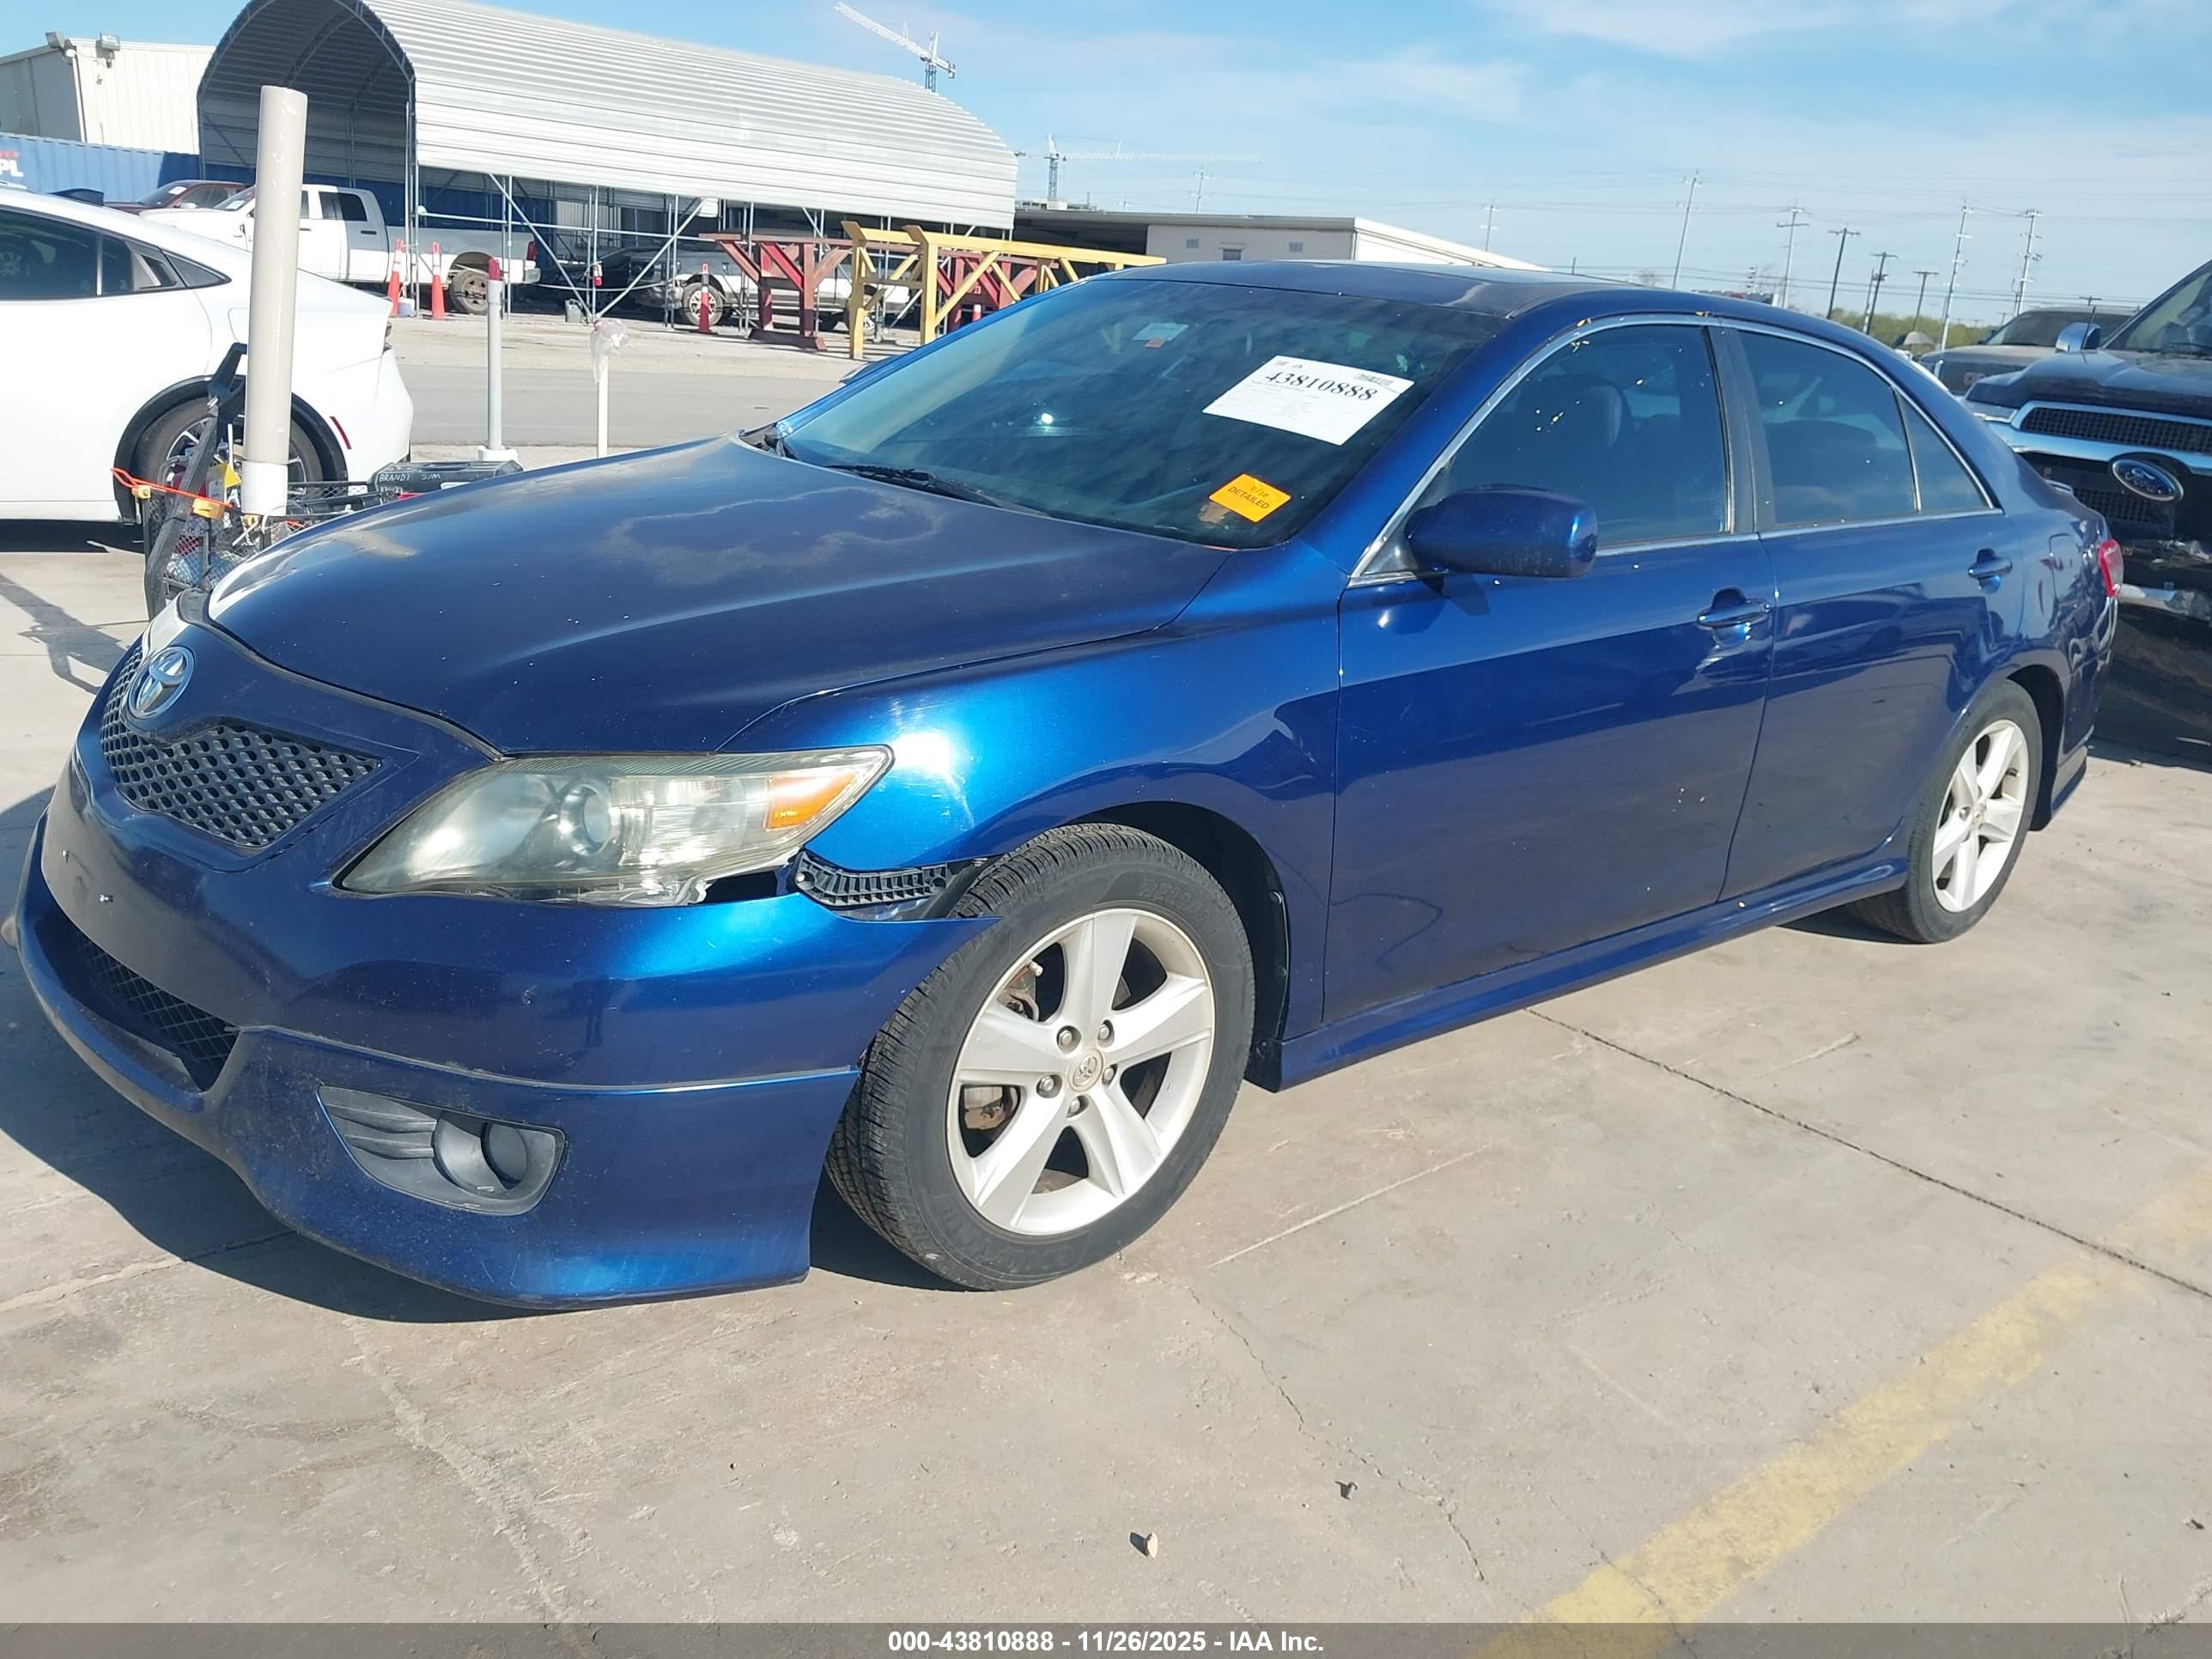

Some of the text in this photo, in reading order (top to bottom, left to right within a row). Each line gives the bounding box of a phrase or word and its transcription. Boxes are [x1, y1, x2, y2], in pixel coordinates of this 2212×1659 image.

[1265, 371, 1378, 401] 43810888
[2124, 467, 2172, 495] Ford
[1228, 486, 1270, 509] DETAILED
